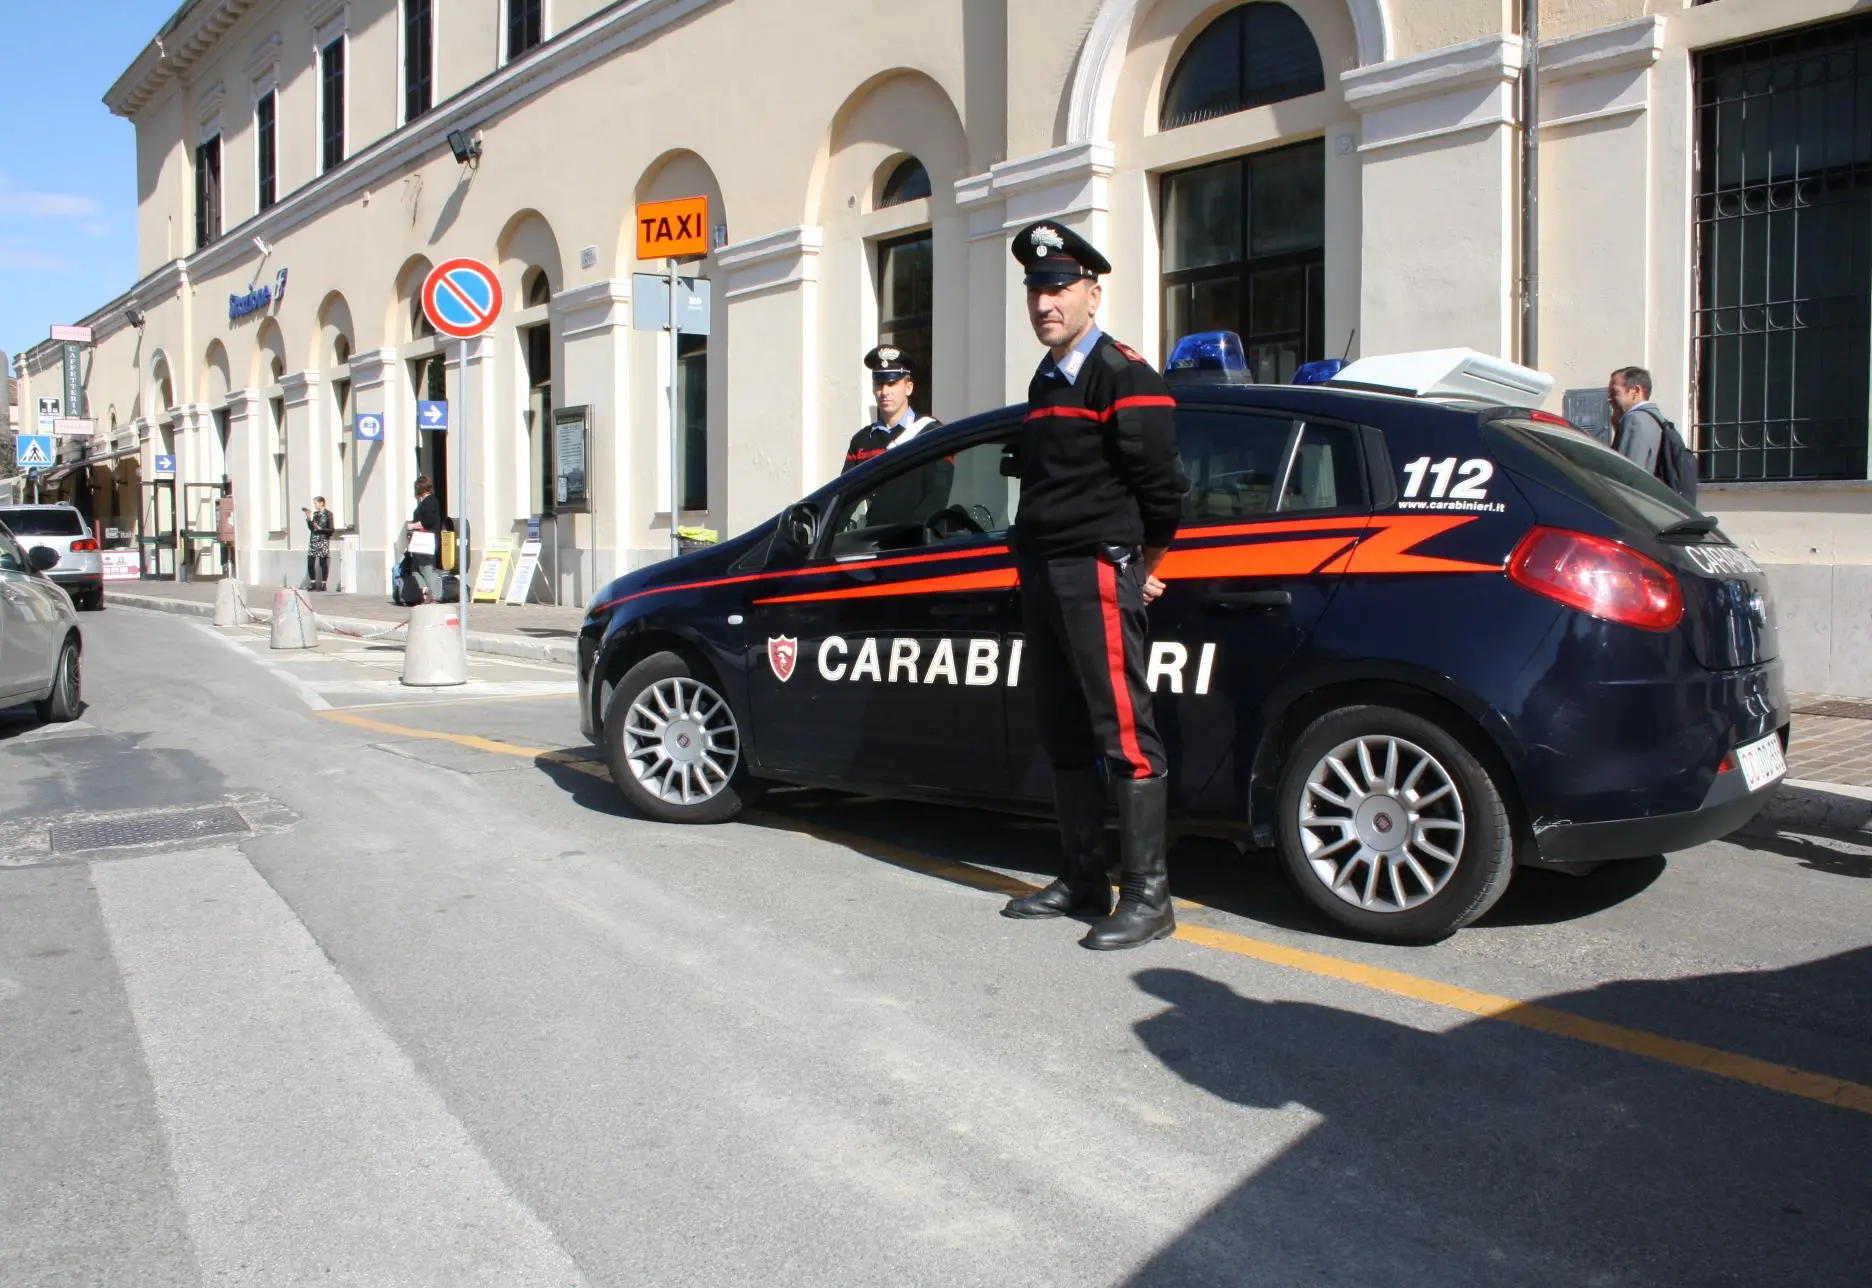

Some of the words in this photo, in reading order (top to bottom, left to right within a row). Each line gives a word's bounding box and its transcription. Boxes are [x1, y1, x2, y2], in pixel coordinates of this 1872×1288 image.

[641, 212, 701, 243] TAXI
[68, 345, 78, 415] CAFFETTERIA
[1403, 456, 1493, 499] 112
[1398, 500, 1505, 512] www.carabinieri.it
[817, 635, 1217, 695] CARABIRI
